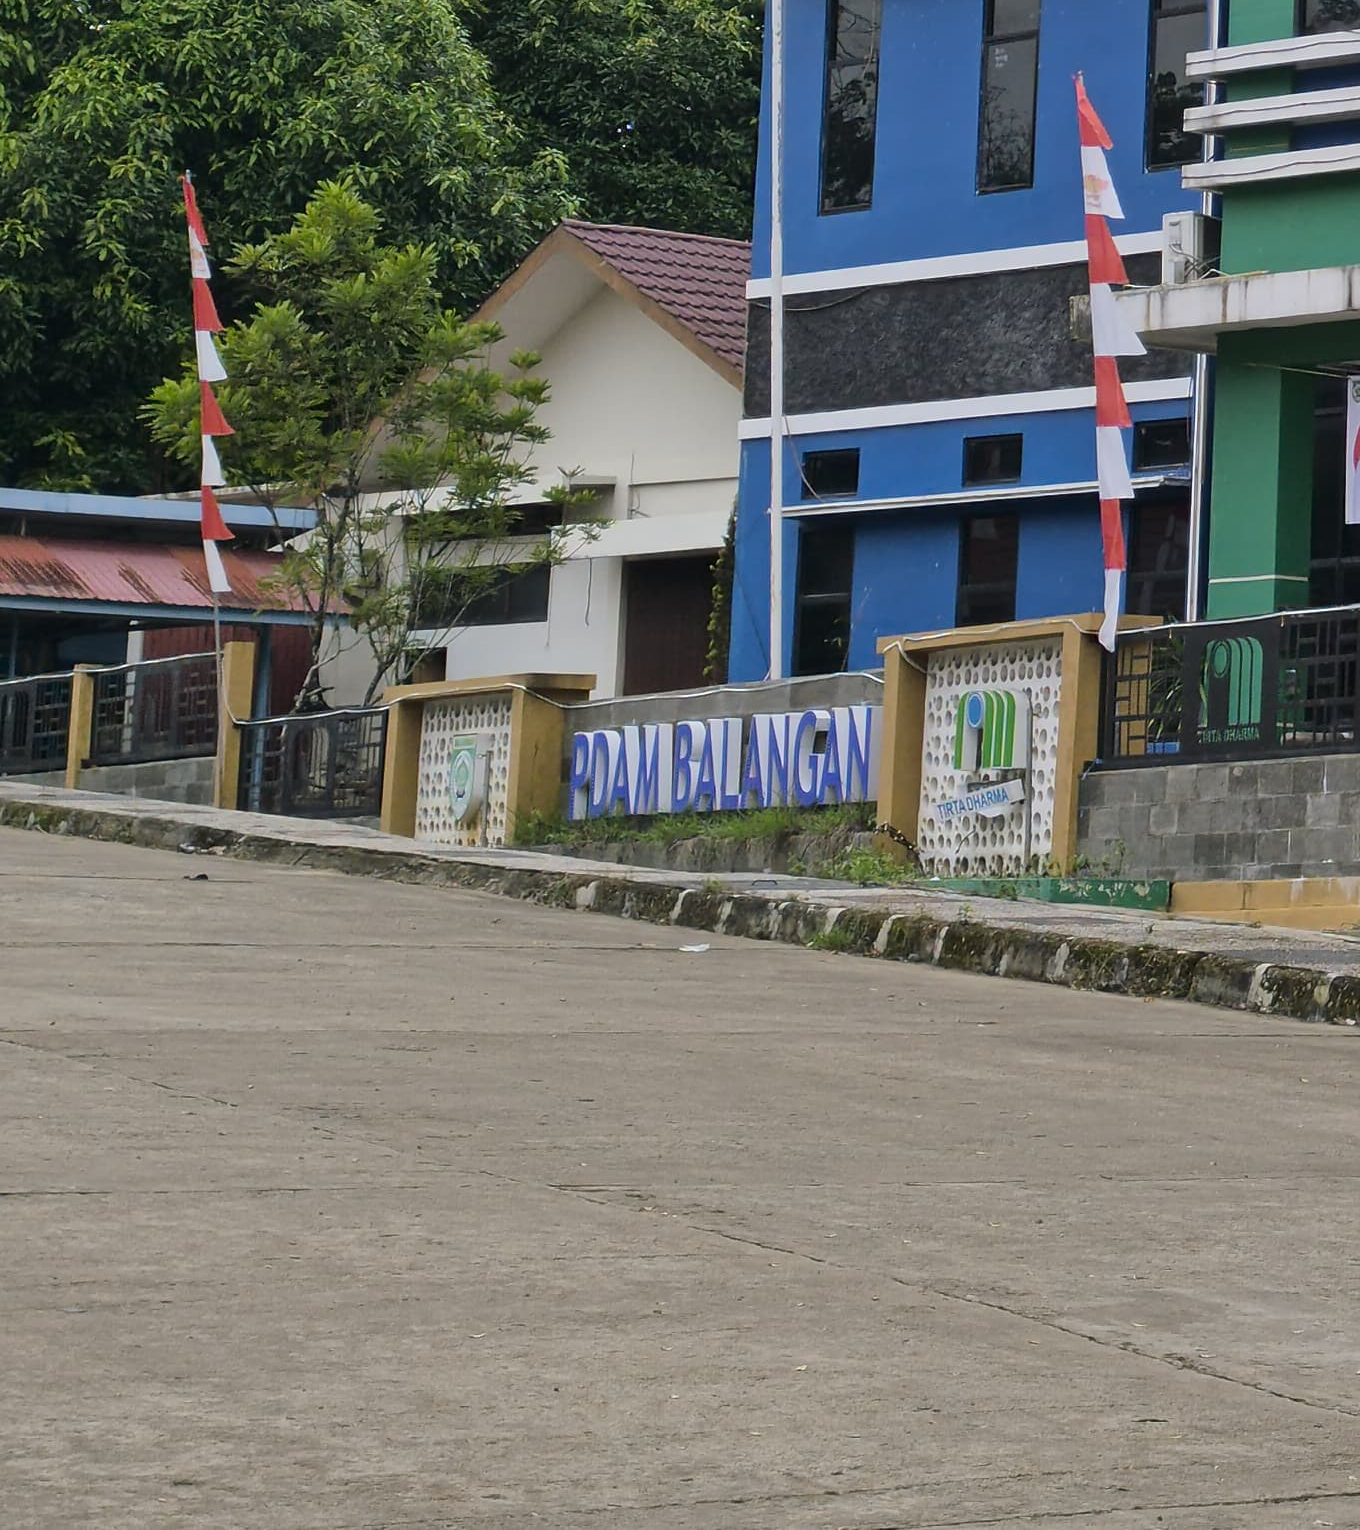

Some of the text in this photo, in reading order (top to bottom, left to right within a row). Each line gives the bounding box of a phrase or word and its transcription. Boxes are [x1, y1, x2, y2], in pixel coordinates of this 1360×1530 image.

[567, 705, 872, 820] PDAM BALANGAN
[937, 787, 1009, 819] TIRTA DHARMA
